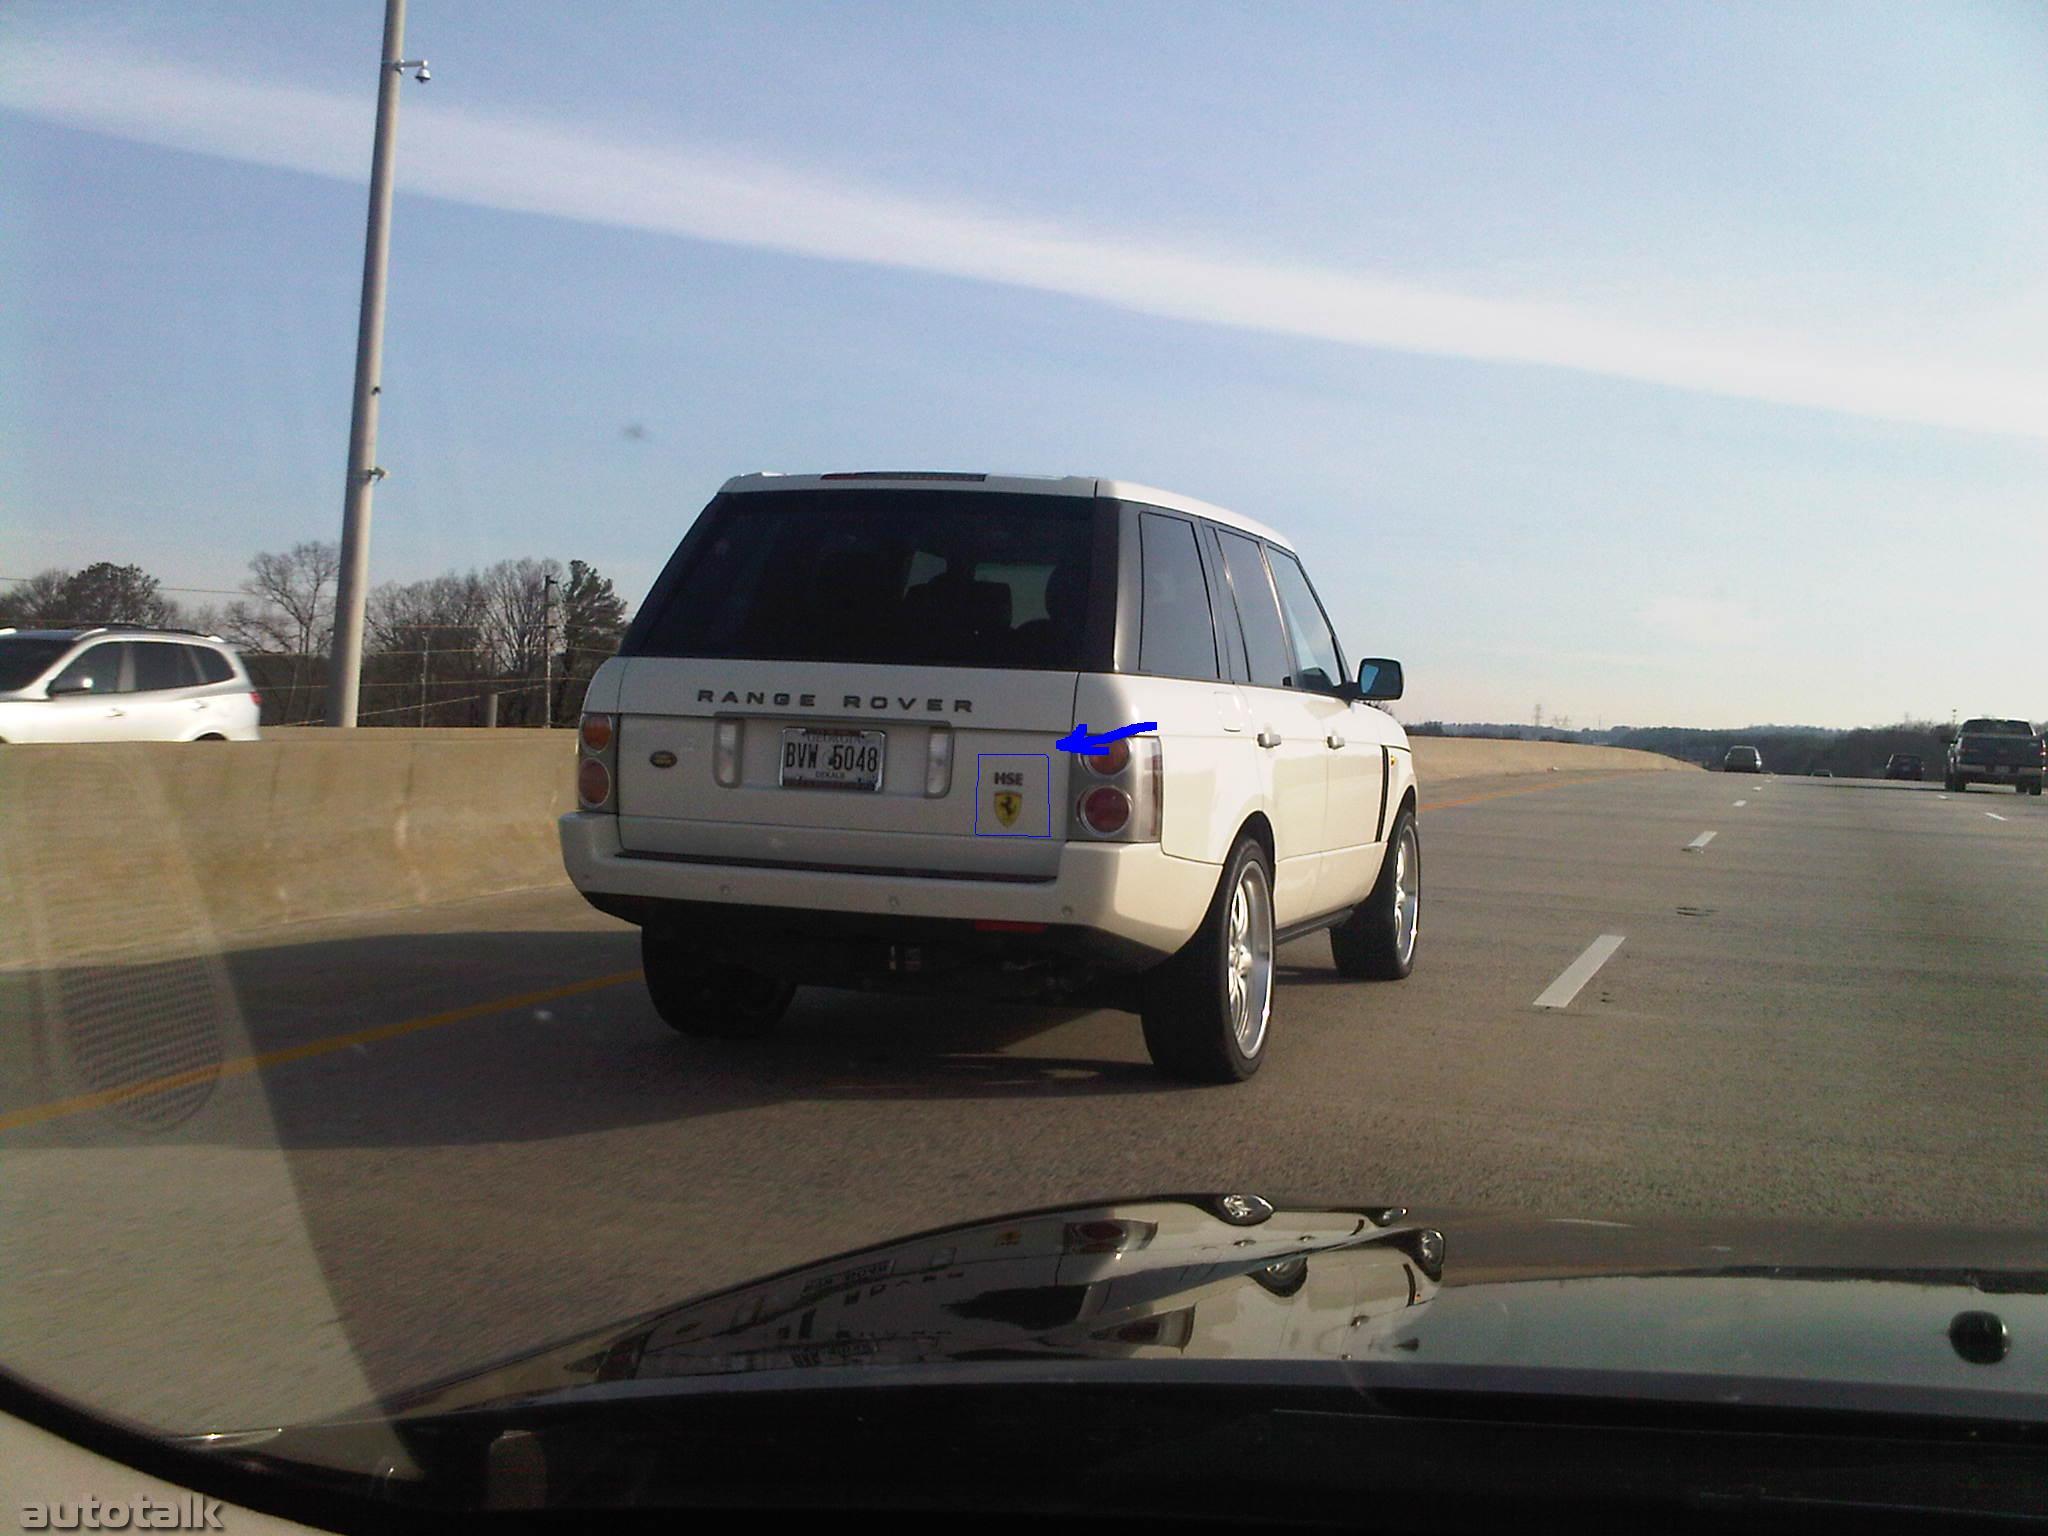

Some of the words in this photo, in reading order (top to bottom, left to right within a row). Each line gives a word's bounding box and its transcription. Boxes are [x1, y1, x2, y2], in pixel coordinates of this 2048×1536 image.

[697, 689, 817, 707] RANGE
[844, 695, 974, 713] ROVER
[786, 742, 818, 769] BVW
[832, 745, 879, 773] 5048
[994, 772, 1024, 787] HSE
